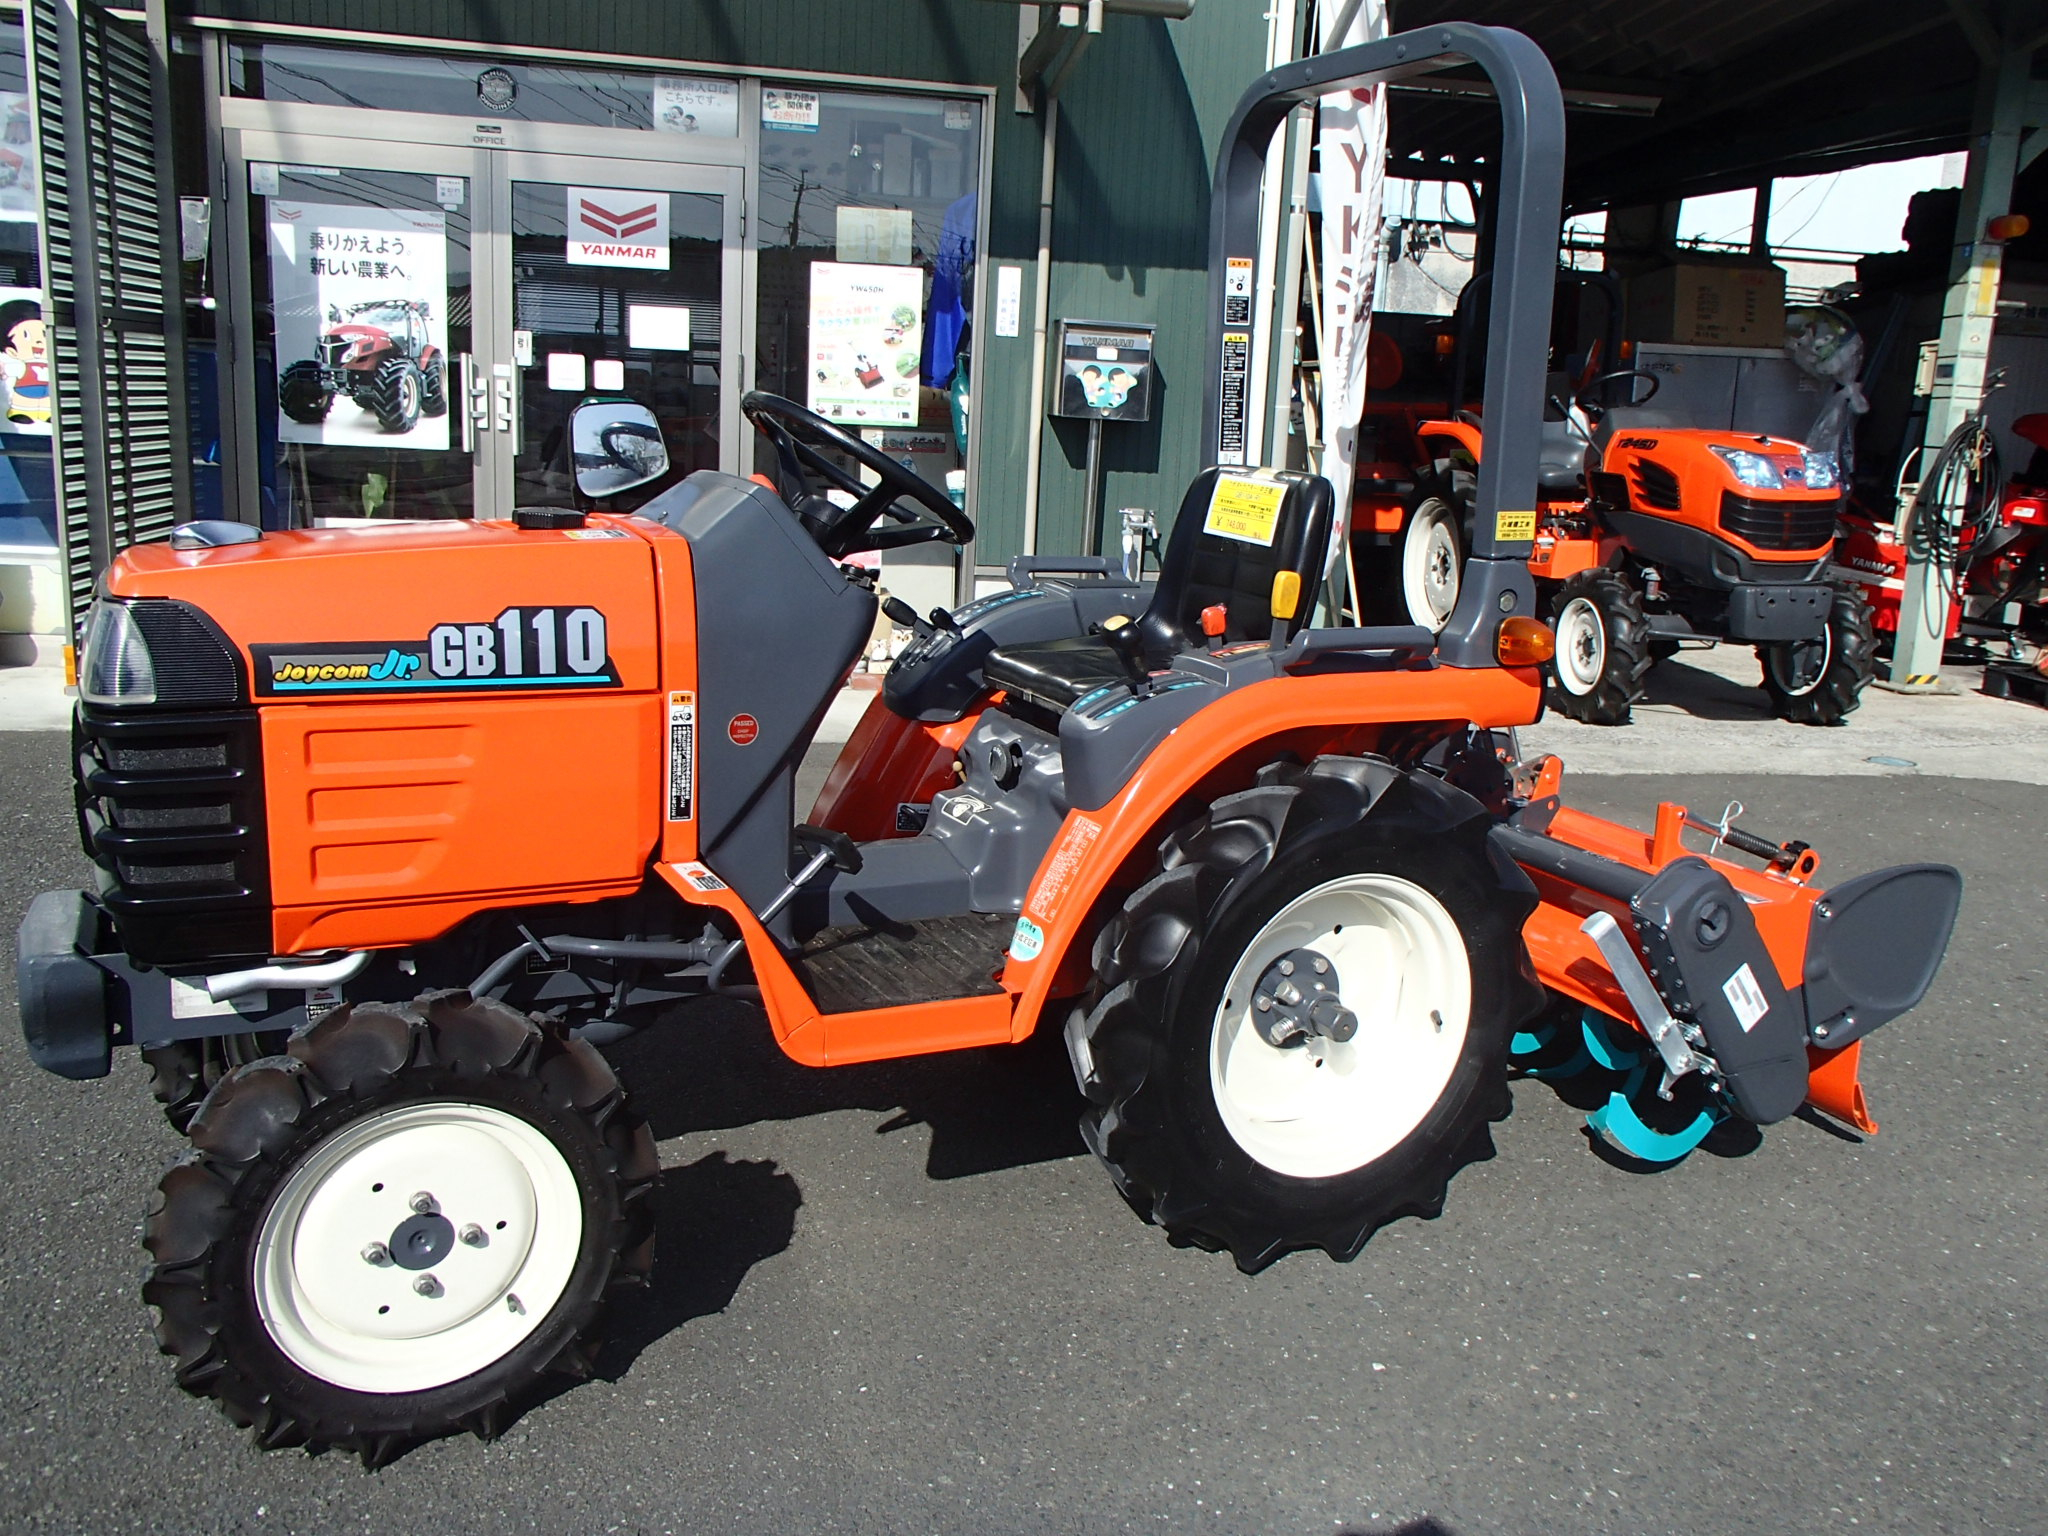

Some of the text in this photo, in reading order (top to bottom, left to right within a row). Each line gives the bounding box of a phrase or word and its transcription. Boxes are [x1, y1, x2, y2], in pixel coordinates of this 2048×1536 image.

[660, 79, 730, 95] 事務所入口は
[480, 94, 514, 110] ORIGINAL
[665, 92, 721, 107] こちらです。
[787, 101, 812, 111] 関係者
[473, 136, 507, 145] OFFICE
[309, 232, 412, 256] 乗りかえよう。
[581, 243, 657, 259] YANMAR
[310, 257, 412, 281] 新しい農業へ。
[1081, 336, 1135, 348] YANMAR
[1851, 556, 1896, 575] YANMAR
[274, 608, 606, 684] Joycom Jr. GB110
